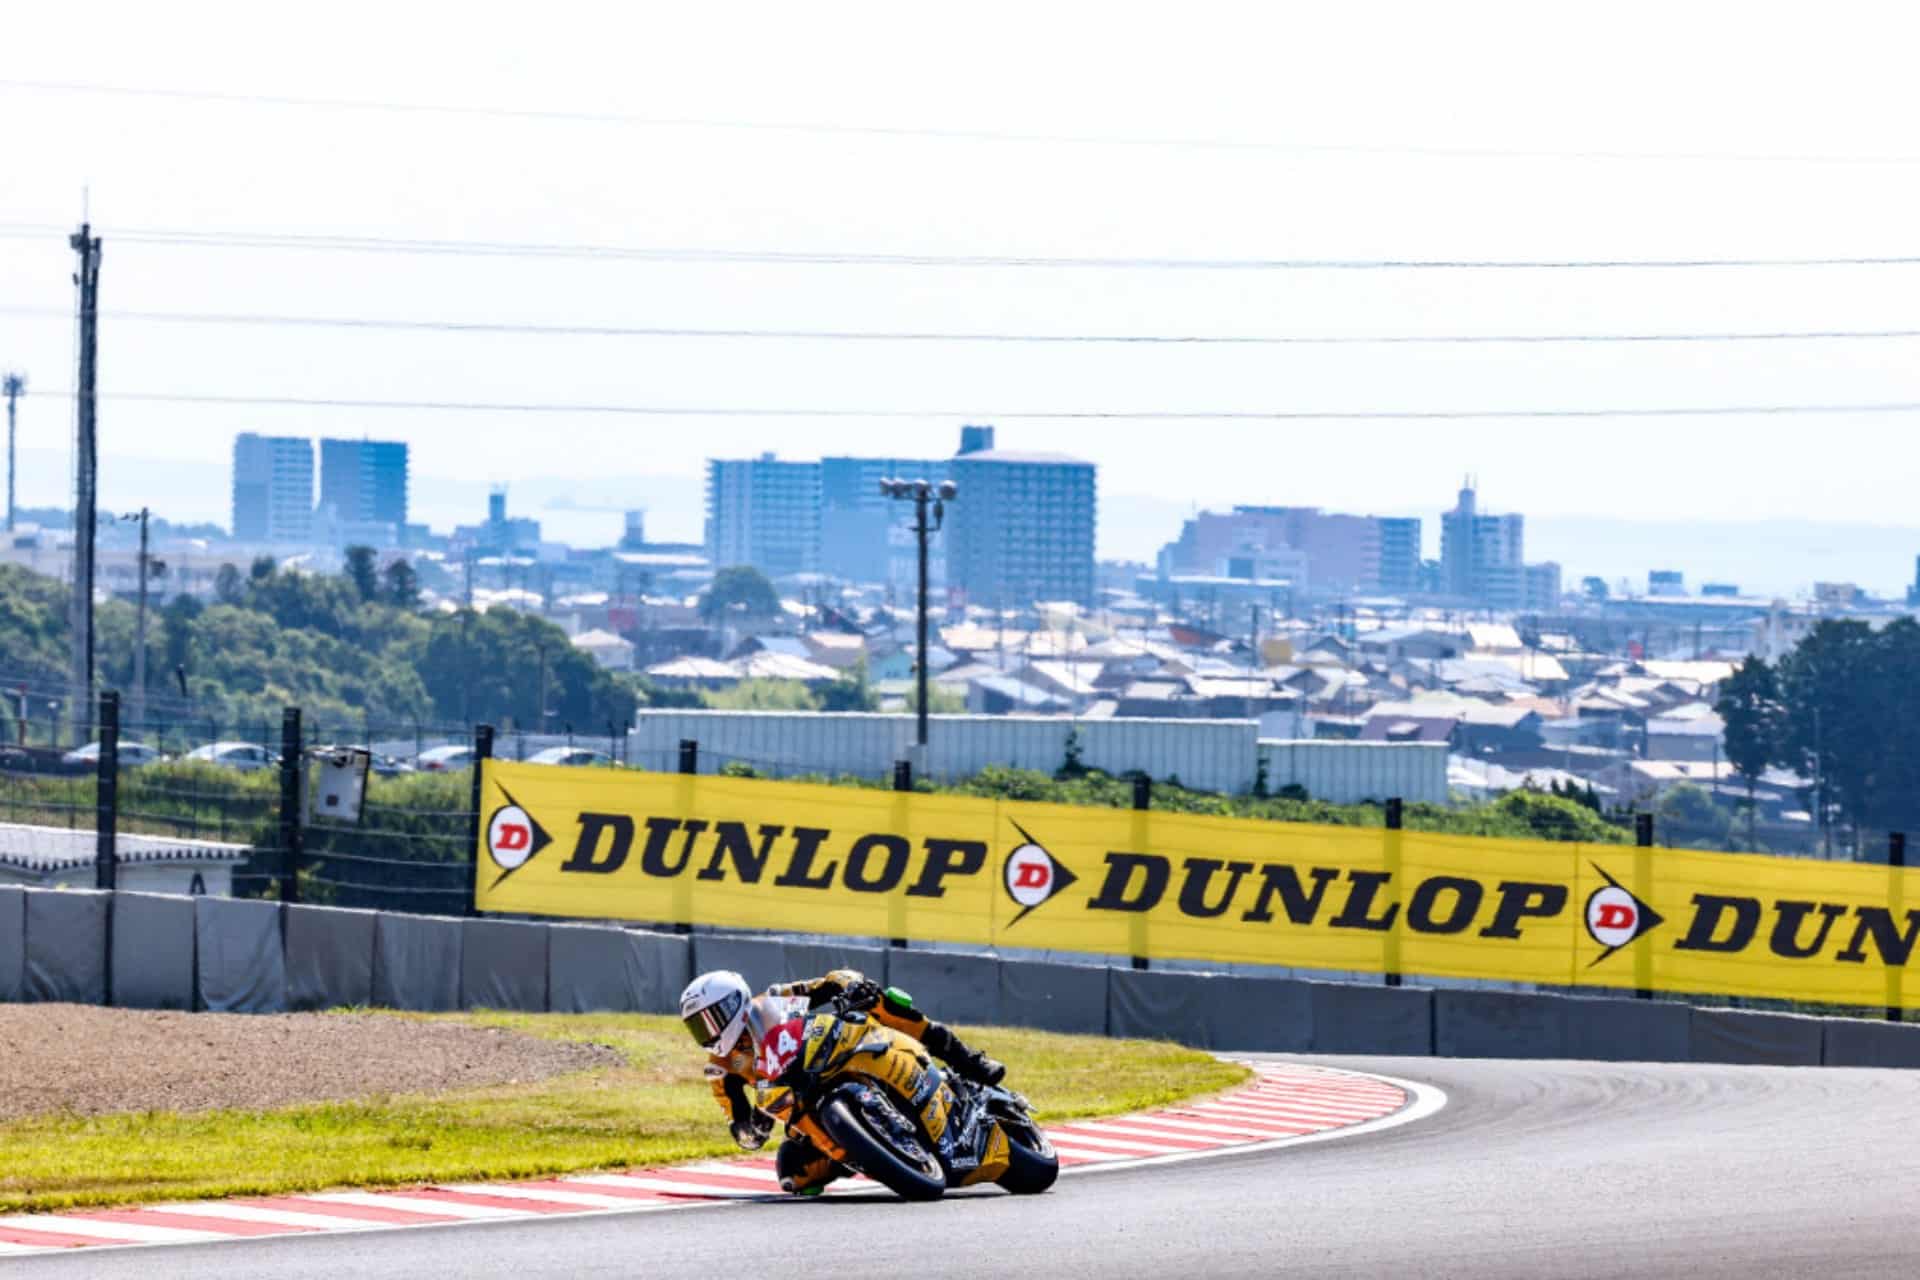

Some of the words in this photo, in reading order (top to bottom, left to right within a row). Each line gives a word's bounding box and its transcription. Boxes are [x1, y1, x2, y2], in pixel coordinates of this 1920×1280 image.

[495, 824, 528, 850] D
[561, 812, 988, 898] DUNLOP
[1014, 863, 1049, 888] D
[1087, 852, 1569, 940] DUNLOP
[1594, 904, 1635, 929] D
[1673, 893, 1920, 967] DUN
